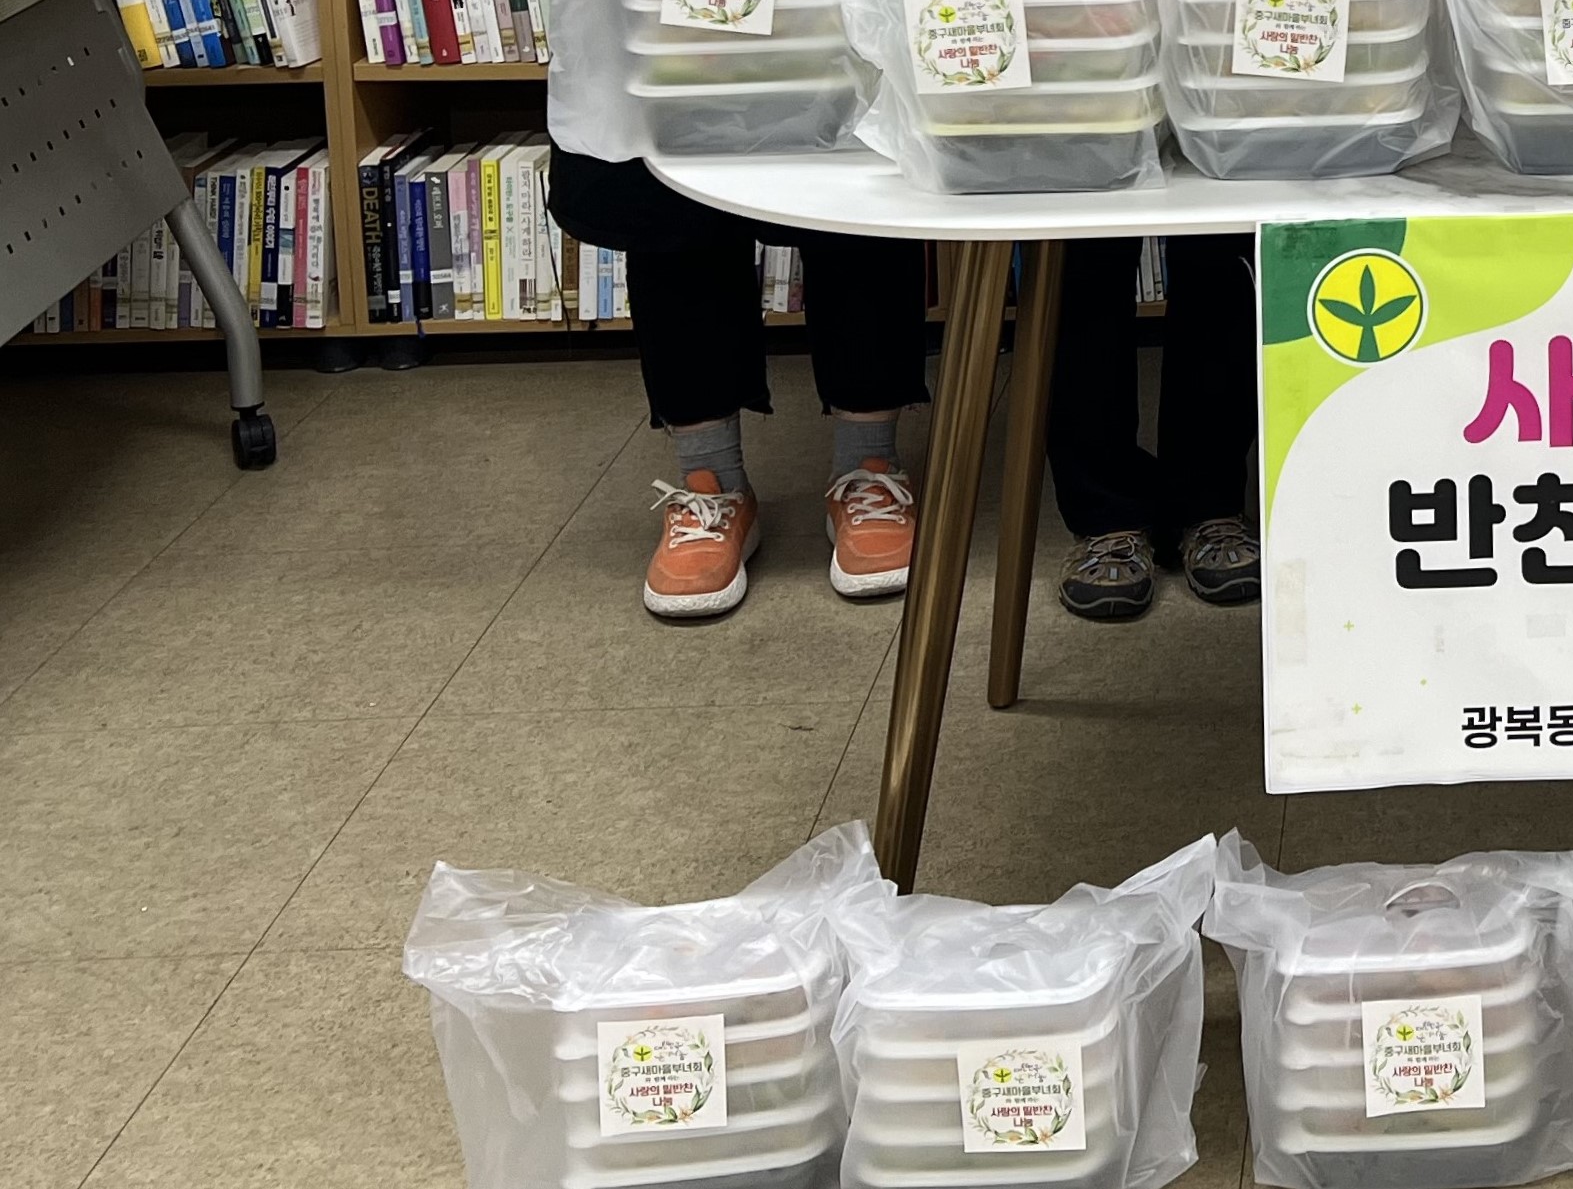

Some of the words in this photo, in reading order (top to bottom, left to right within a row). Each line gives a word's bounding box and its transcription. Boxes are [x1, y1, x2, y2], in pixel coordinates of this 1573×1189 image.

[362, 187, 383, 244] DEATH
[1392, 1066, 1421, 1076] 사랑의
[630, 1086, 659, 1097] 사랑의
[991, 1106, 1020, 1117] 사랑의
